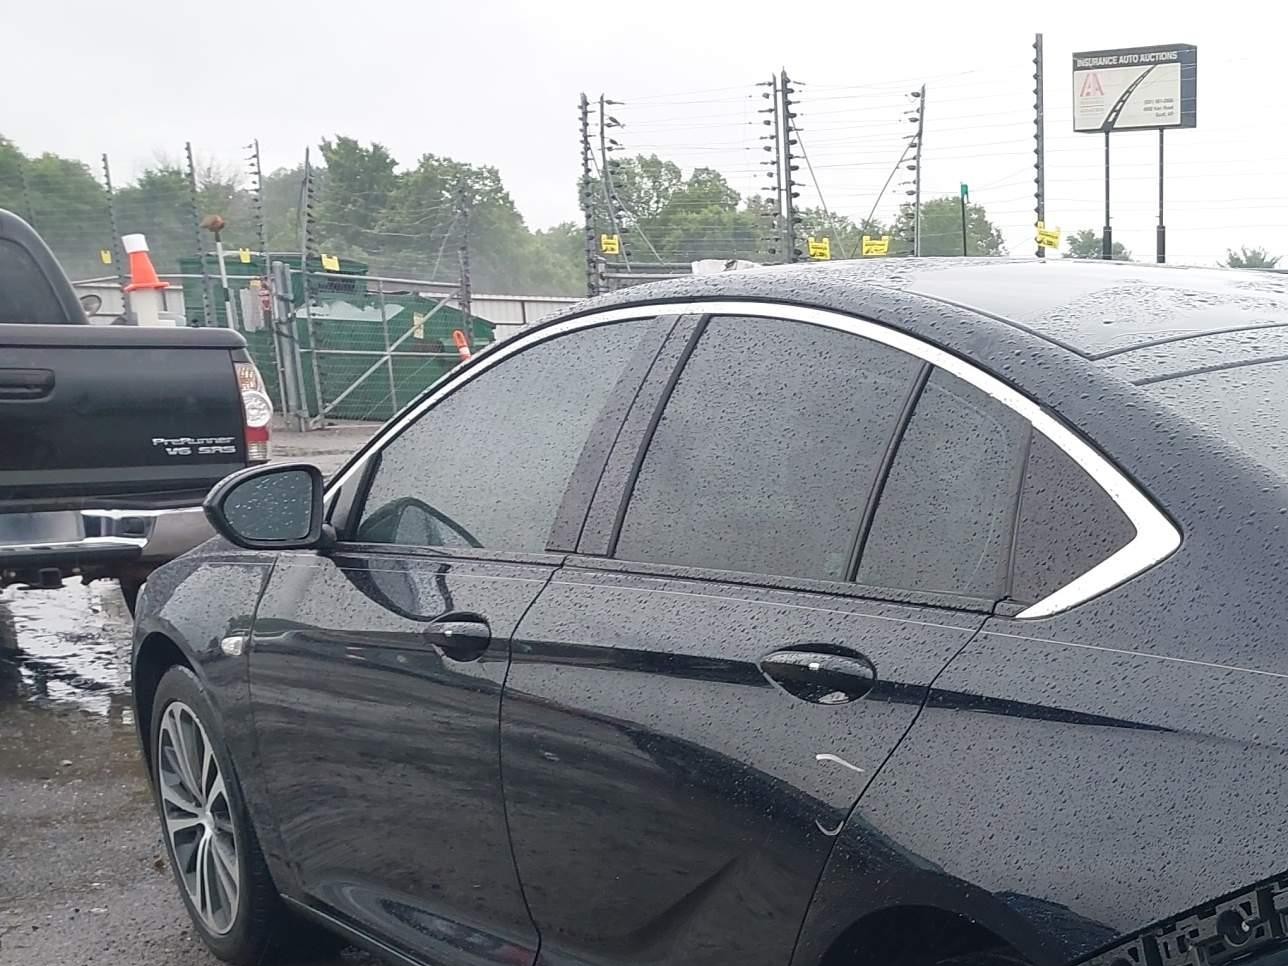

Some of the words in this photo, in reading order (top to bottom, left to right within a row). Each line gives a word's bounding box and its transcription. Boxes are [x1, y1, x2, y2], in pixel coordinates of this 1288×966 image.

[1077, 56, 1118, 68] INSURANCE
[1119, 54, 1138, 64] AUTO
[1140, 51, 1178, 62] AUCTIONS
[165, 447, 192, 455] V6
